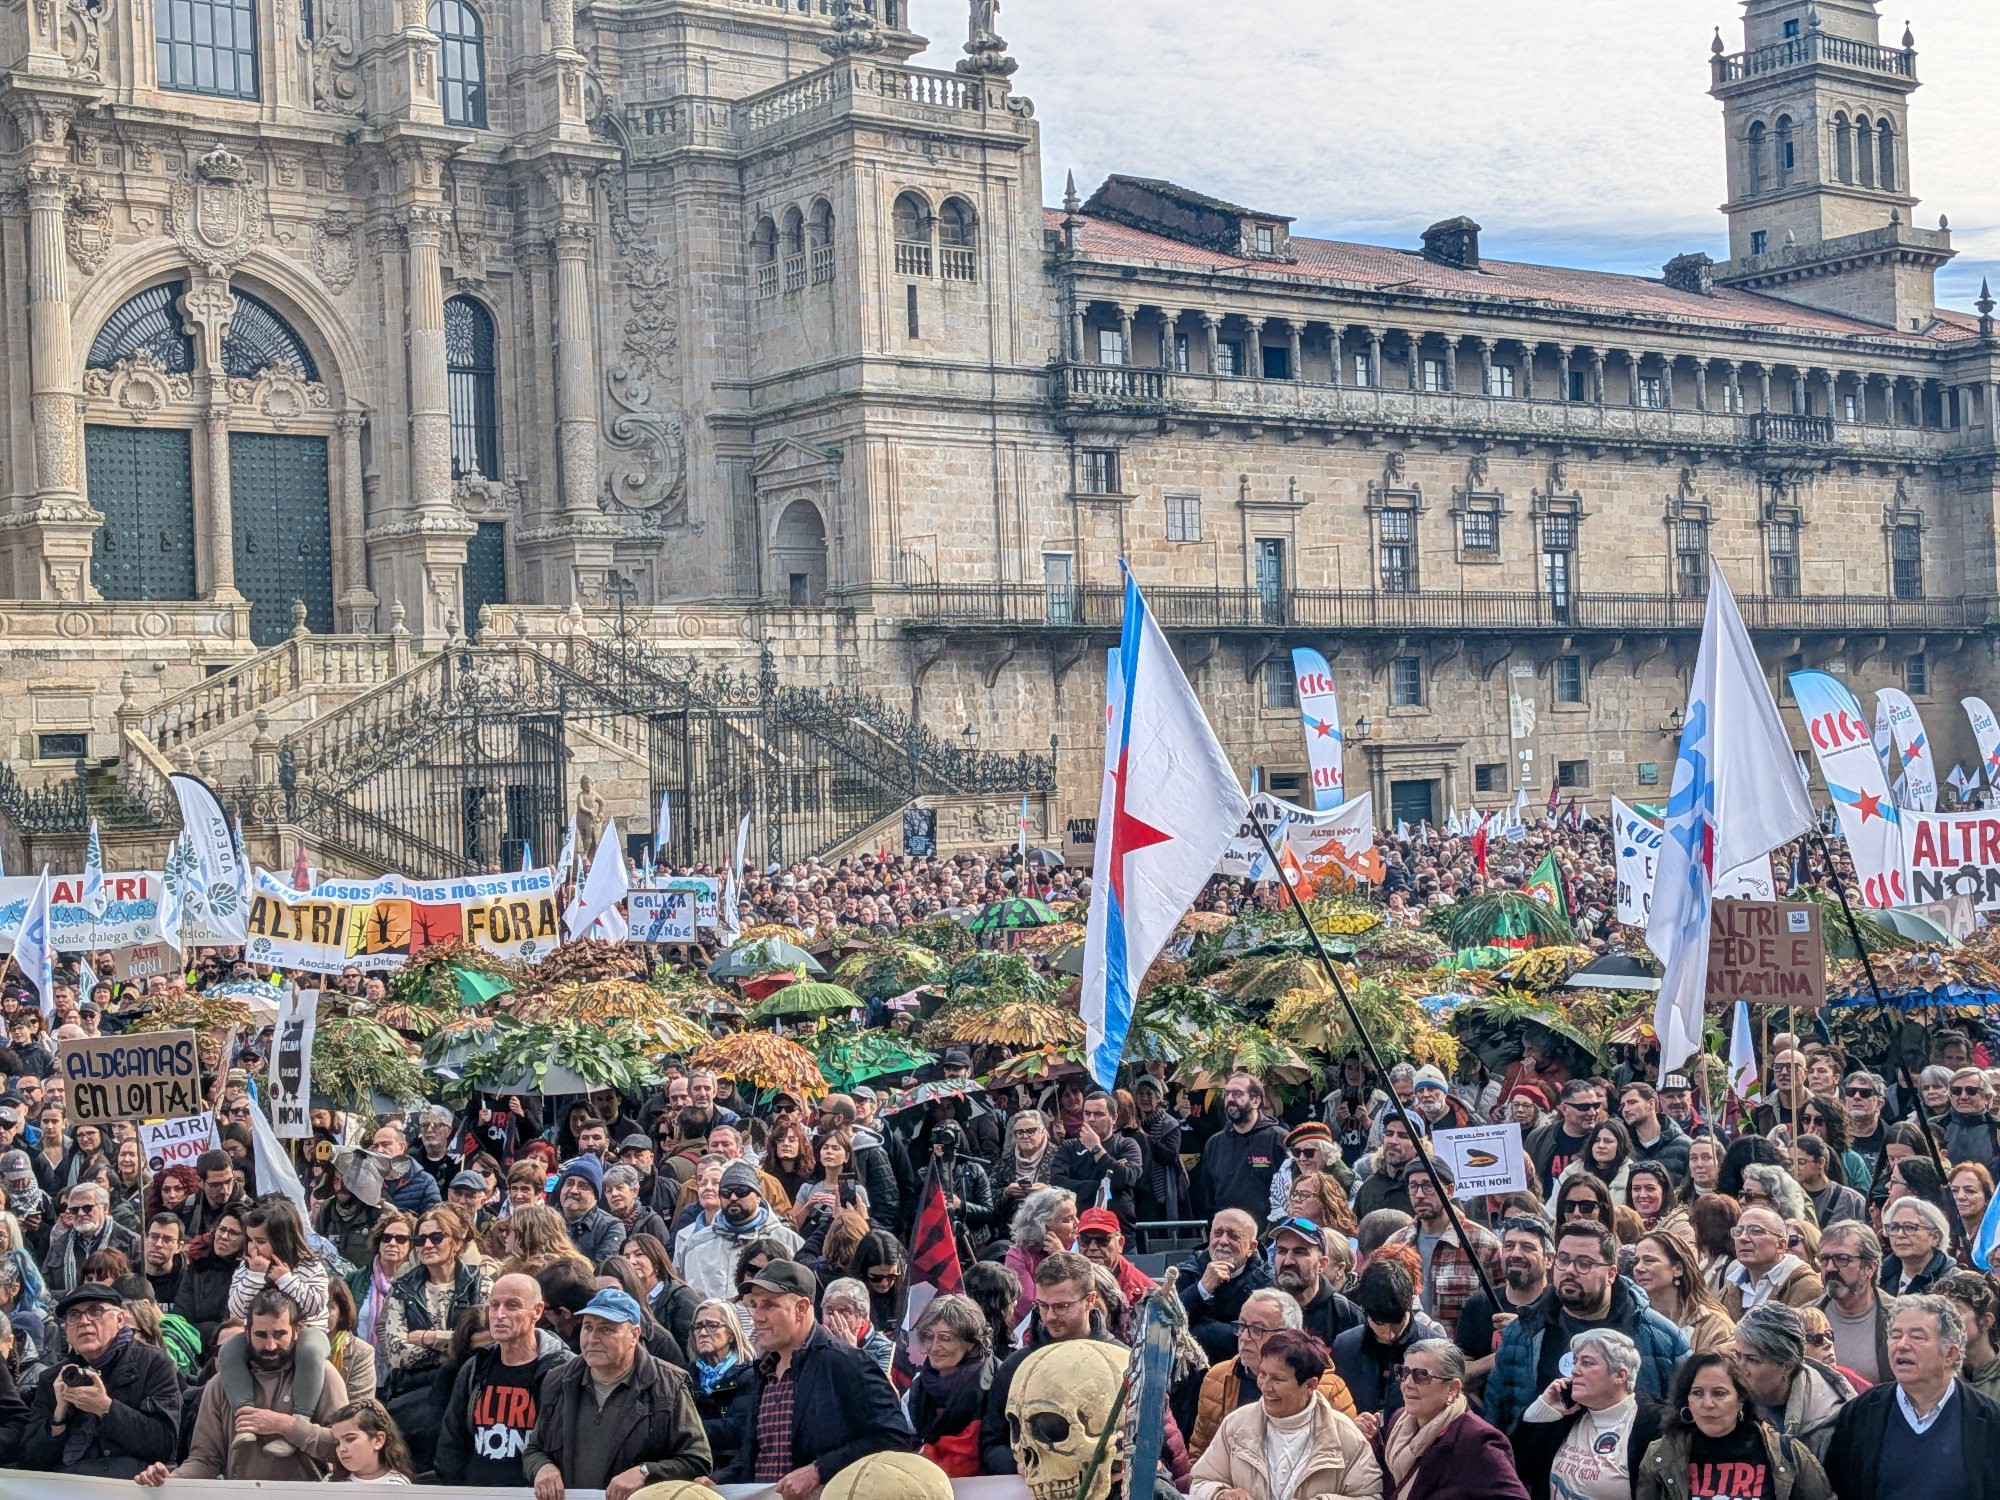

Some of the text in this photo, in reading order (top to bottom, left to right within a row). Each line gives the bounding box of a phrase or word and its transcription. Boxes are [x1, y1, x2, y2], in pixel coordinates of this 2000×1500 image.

[451, 882, 508, 899] nosas
[511, 873, 551, 893] rías
[633, 892, 687, 909] GALIZA
[249, 895, 346, 946] ALTRI
[466, 896, 557, 944] FÓRA
[131, 945, 159, 962] ALTRI
[66, 1040, 194, 1081] ALDEANAS
[115, 1078, 199, 1116] LOITA!
[151, 1116, 209, 1143] ALTRI
